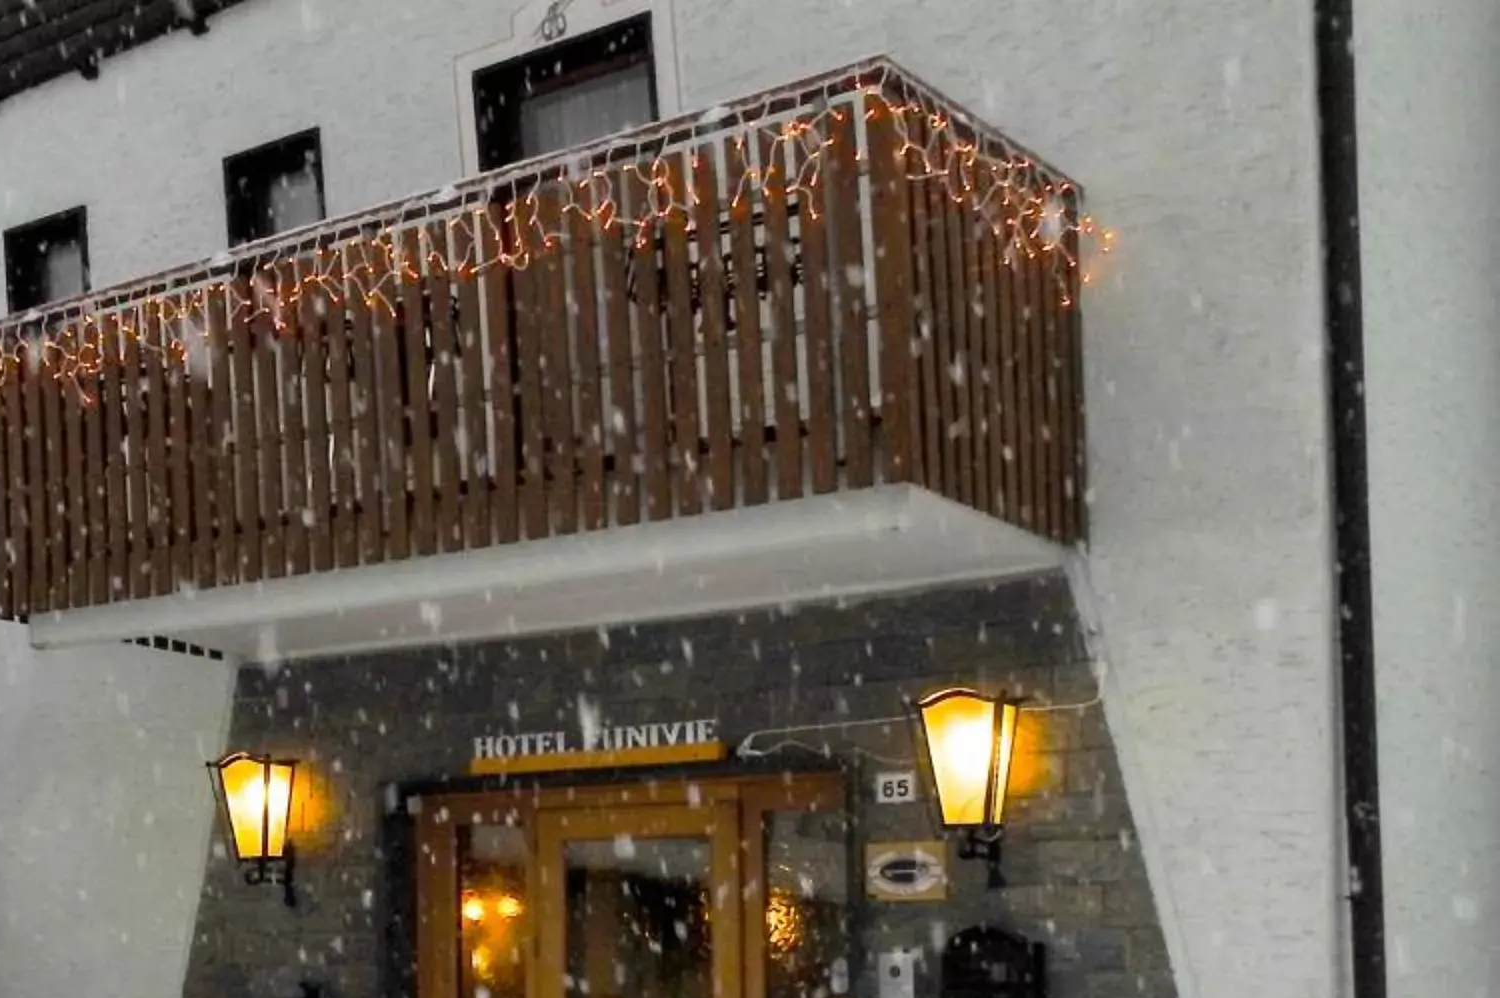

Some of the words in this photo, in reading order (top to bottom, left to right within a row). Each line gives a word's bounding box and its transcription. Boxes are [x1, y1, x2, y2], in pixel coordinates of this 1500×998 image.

[473, 731, 575, 760] HOTEL
[583, 718, 720, 753] FUNIVIE
[882, 779, 910, 798] 65
